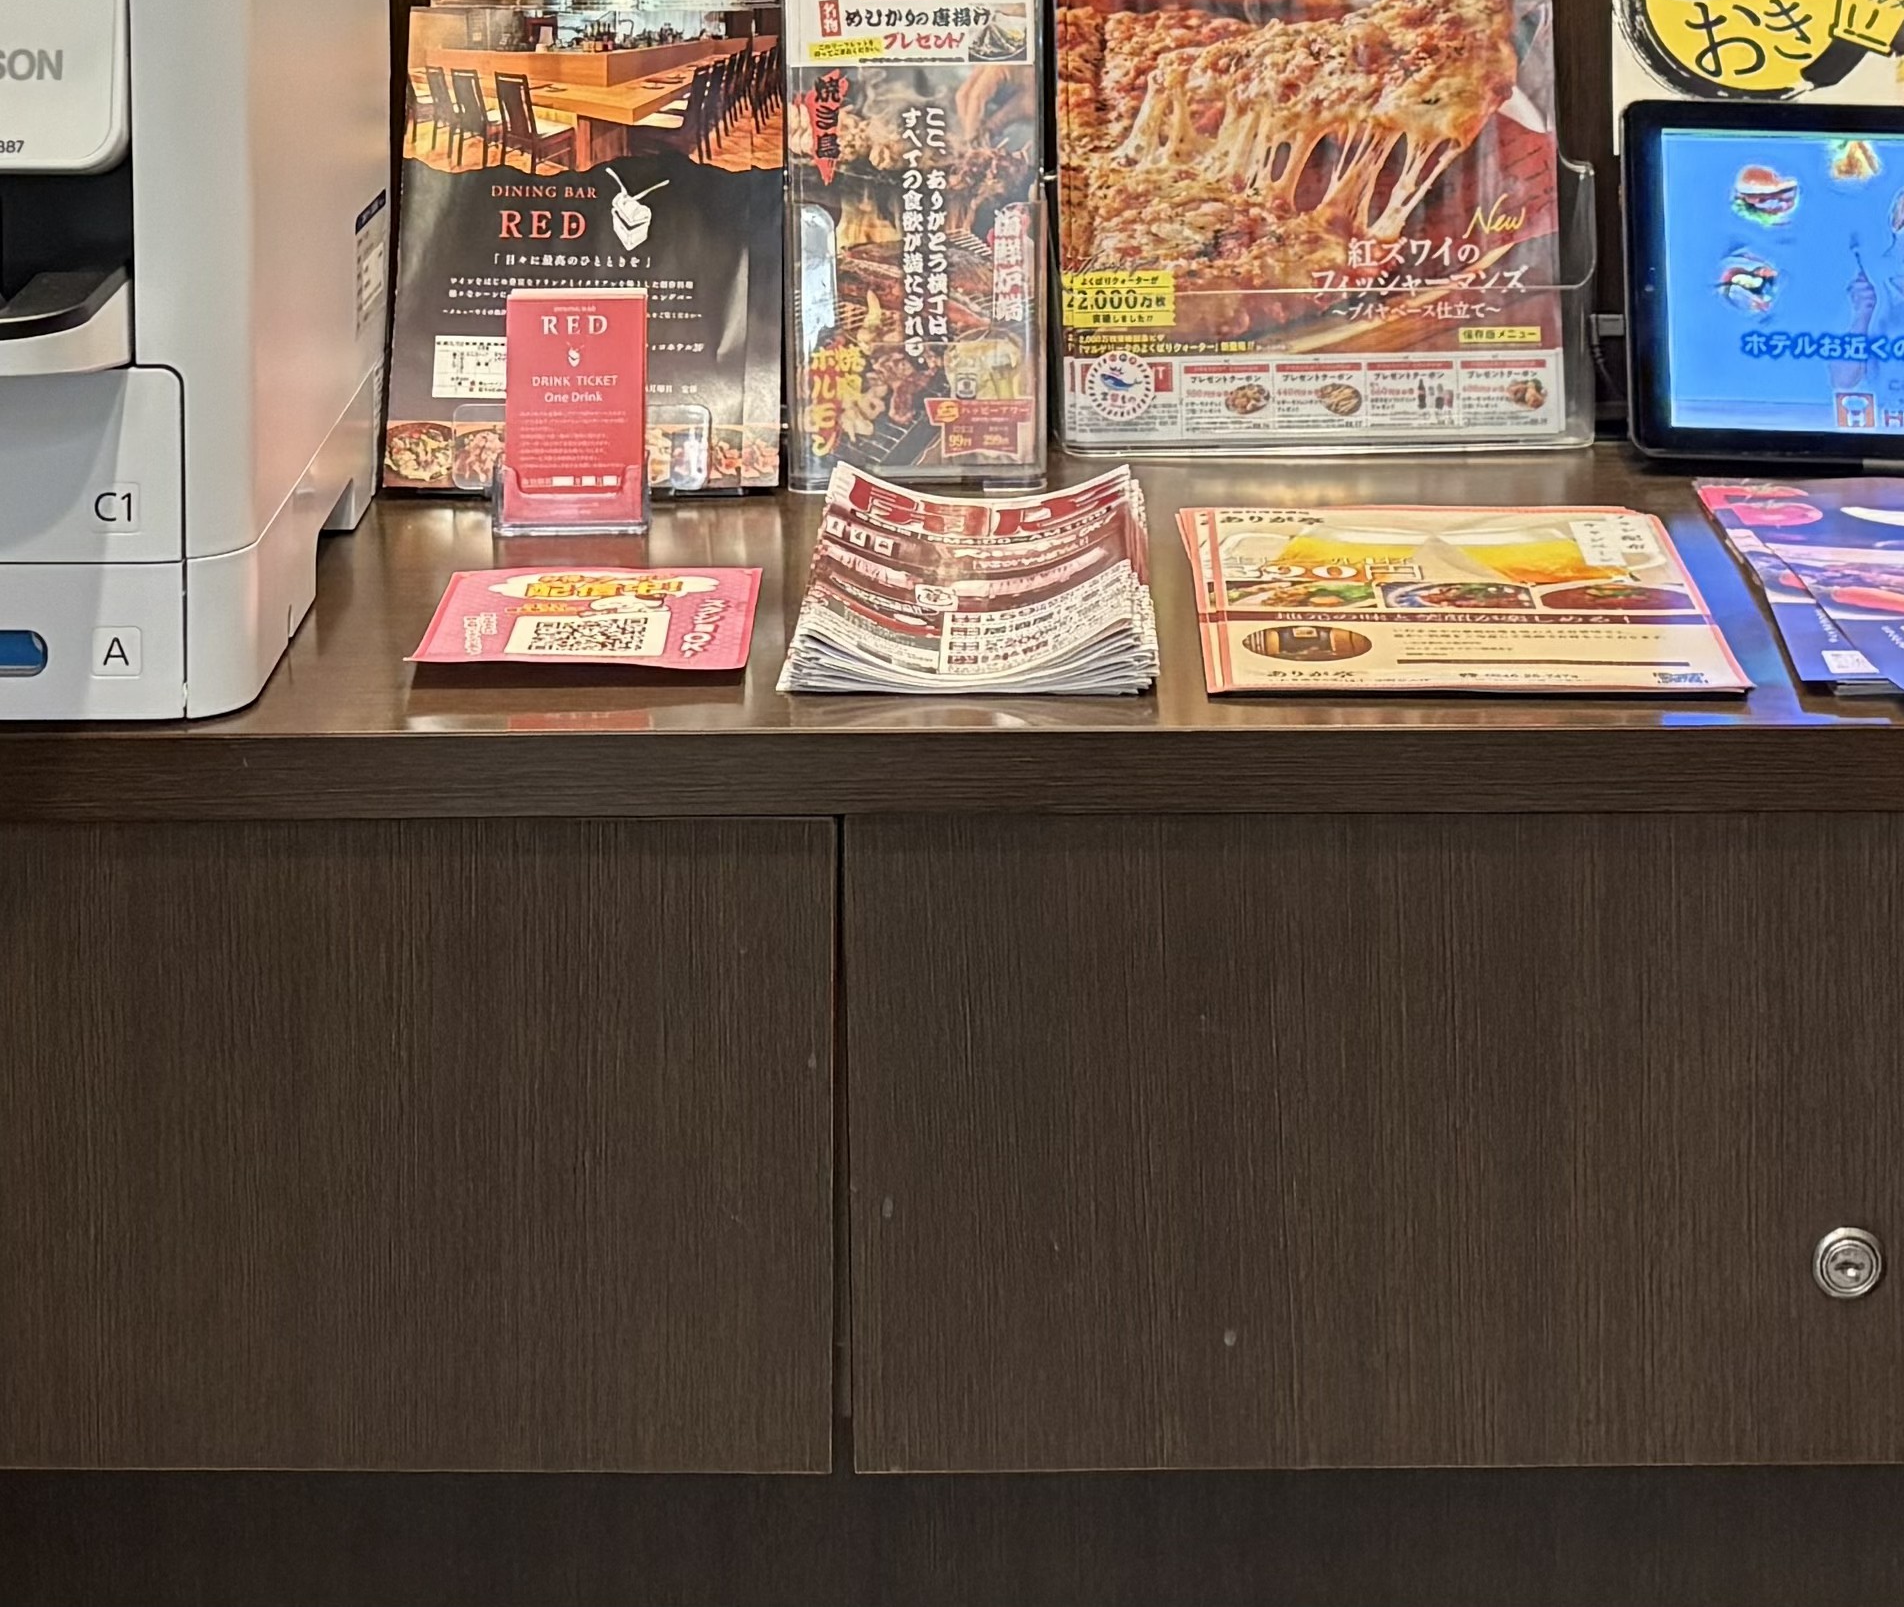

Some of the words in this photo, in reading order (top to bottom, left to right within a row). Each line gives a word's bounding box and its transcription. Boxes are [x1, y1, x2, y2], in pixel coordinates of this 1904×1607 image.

[491, 184, 558, 199] DINING
[564, 185, 598, 200] BAR
[498, 210, 587, 240] RED
[1463, 193, 1528, 238] New
[1348, 238, 1481, 266] 紅ズワイの
[1311, 263, 1531, 297] フィッシャーマンズ
[1076, 289, 1167, 311] 2,000万枚
[541, 314, 609, 335] RED
[532, 376, 571, 387] DRINK
[576, 374, 619, 387] TICKET
[544, 392, 570, 403] One
[571, 391, 604, 403] Drink
[94, 491, 133, 522] C1
[103, 637, 130, 667] A
